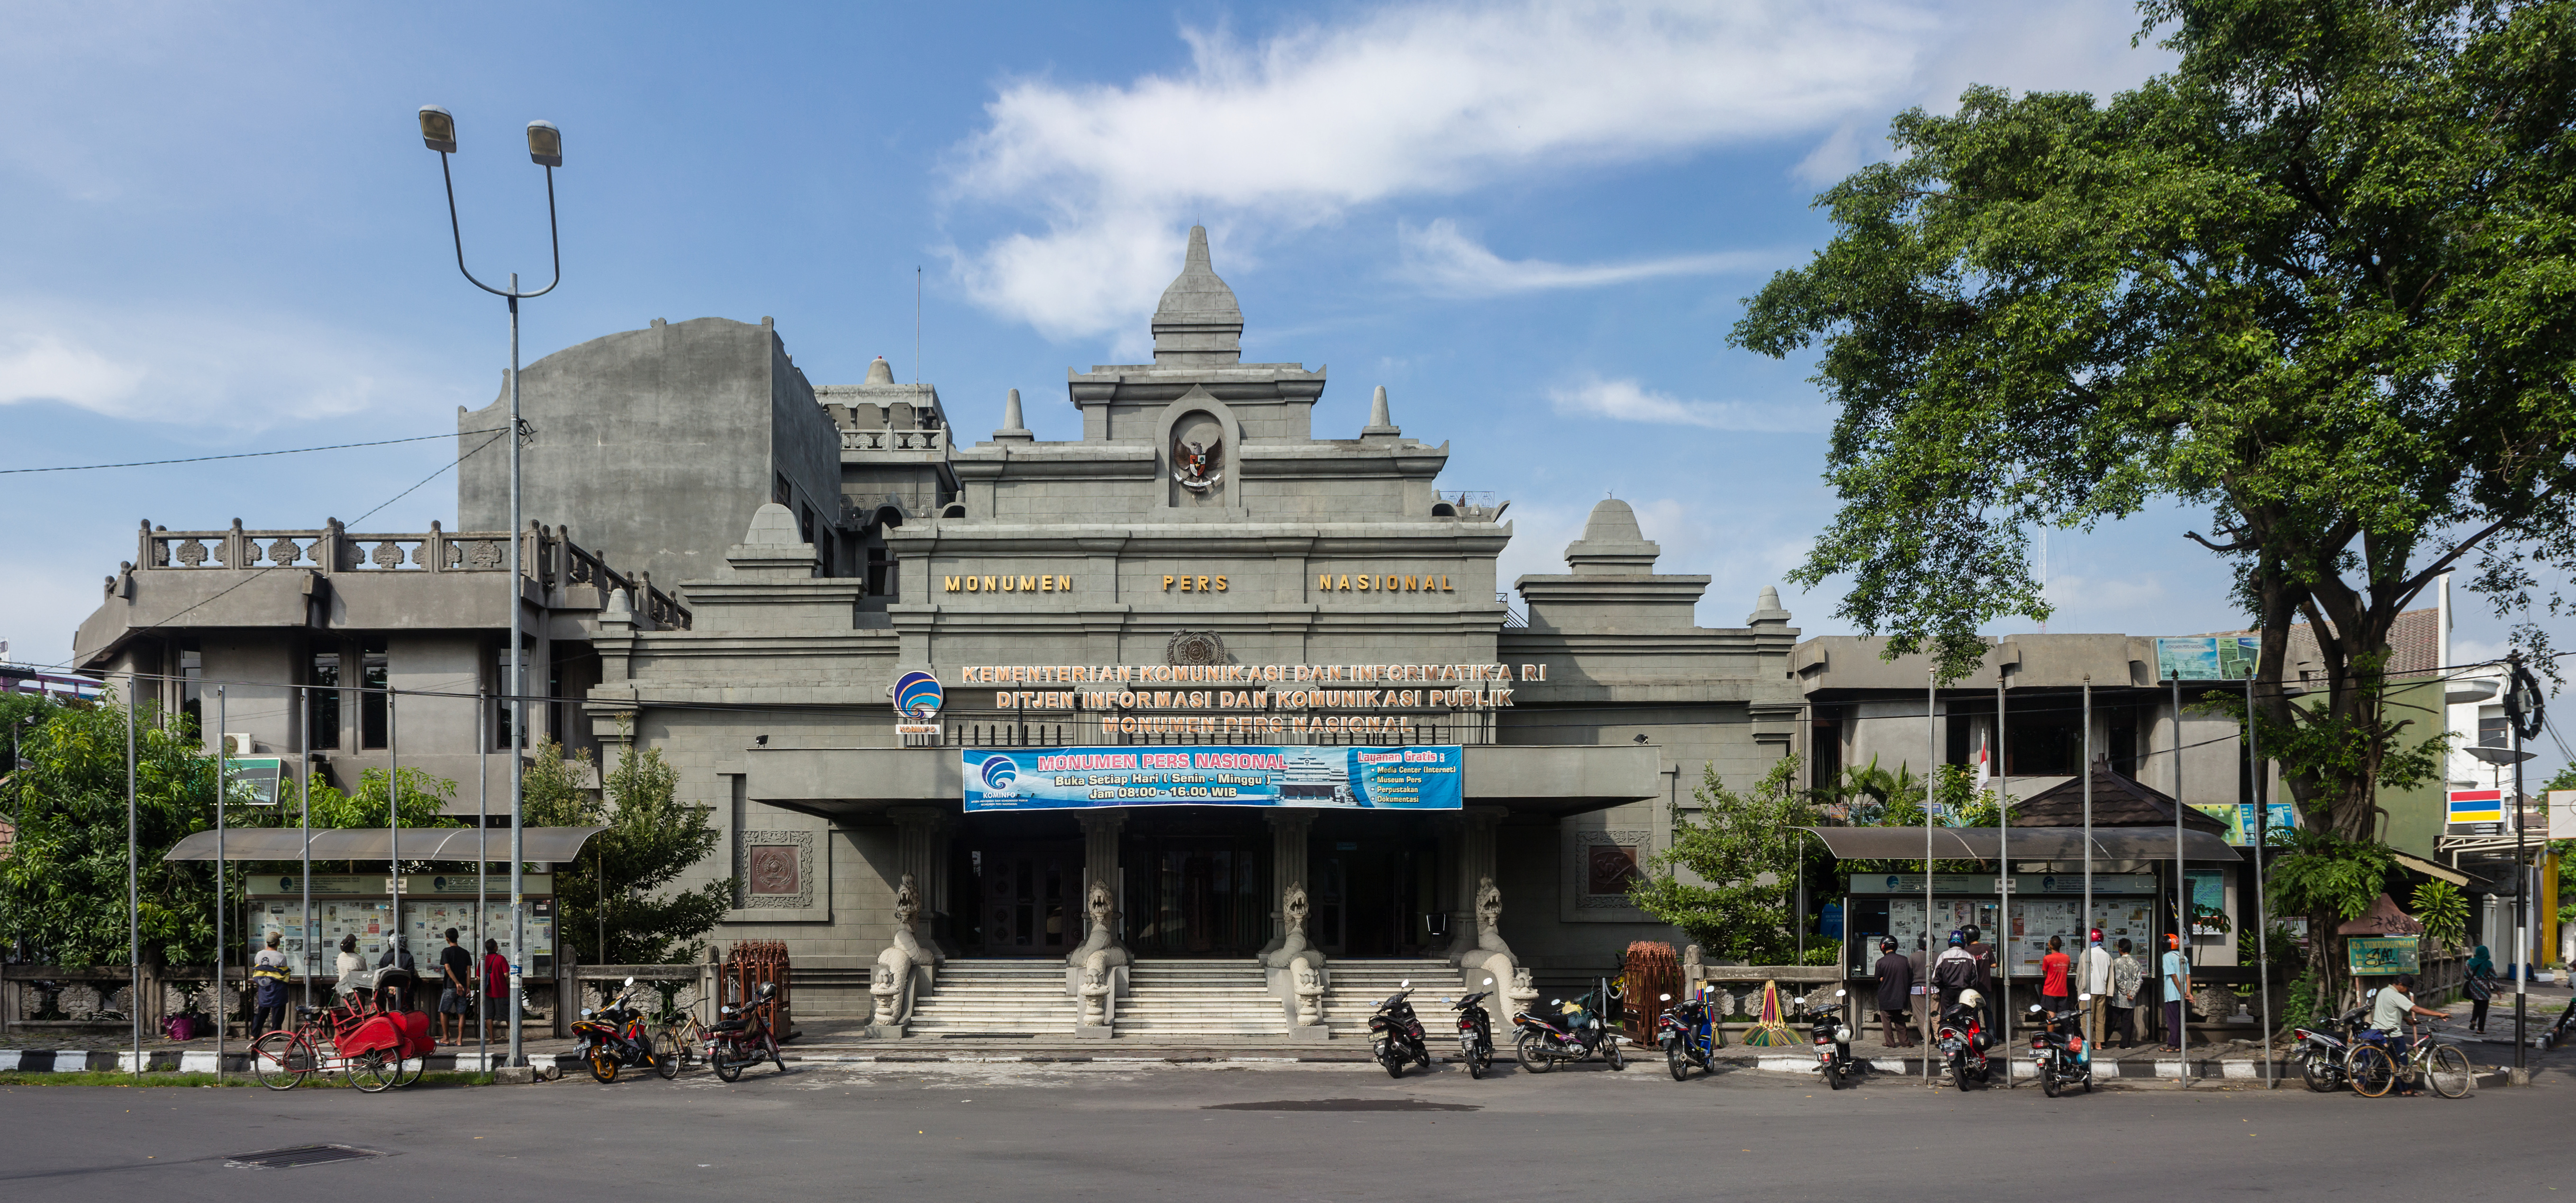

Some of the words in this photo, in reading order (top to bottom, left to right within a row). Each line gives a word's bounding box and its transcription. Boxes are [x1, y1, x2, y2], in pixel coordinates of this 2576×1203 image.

[944, 575, 1070, 591] MONUMEN
[1163, 575, 1227, 591] PERS
[1319, 574, 1452, 590] NASIONAL
[962, 666, 1132, 683] KEMENTERIAN
[1140, 664, 1285, 683] KOMUNIKASI
[1295, 664, 1342, 682] DAN
[1350, 664, 1514, 682] INFORMATIKA
[1522, 664, 1546, 681] RI
[997, 691, 1074, 709] DITJEN
[1083, 691, 1212, 709] INFORMASI
[1220, 690, 1268, 708] DAN
[1279, 690, 1421, 708] KOMUNIKASI
[1430, 689, 1515, 707] PUBLIK
[1103, 717, 1215, 734] MONUMEN
[1224, 717, 1283, 734] PERS
[1292, 716, 1414, 733] NASIONAL
[1038, 754, 1136, 771] MONUMEN
[1142, 753, 1190, 769] PERS
[1195, 753, 1289, 769] NASIONAL
[1358, 751, 1402, 765] Layanan
[1404, 751, 1437, 762] Gratis
[1055, 775, 1085, 787] Buka
[1089, 774, 1128, 786] Setiap
[1132, 773, 1159, 784] Hari
[1171, 773, 1206, 783] Senin
[1217, 774, 1262, 787] Minggu
[1089, 788, 1115, 799] Jam
[1118, 787, 1157, 798] 08.00
[1169, 787, 1207, 797] 16.00
[1210, 787, 1237, 798] WIB
[1377, 786, 1418, 794] Perpustakan
[2364, 941, 2415, 949] TUMENGGUNGAN
